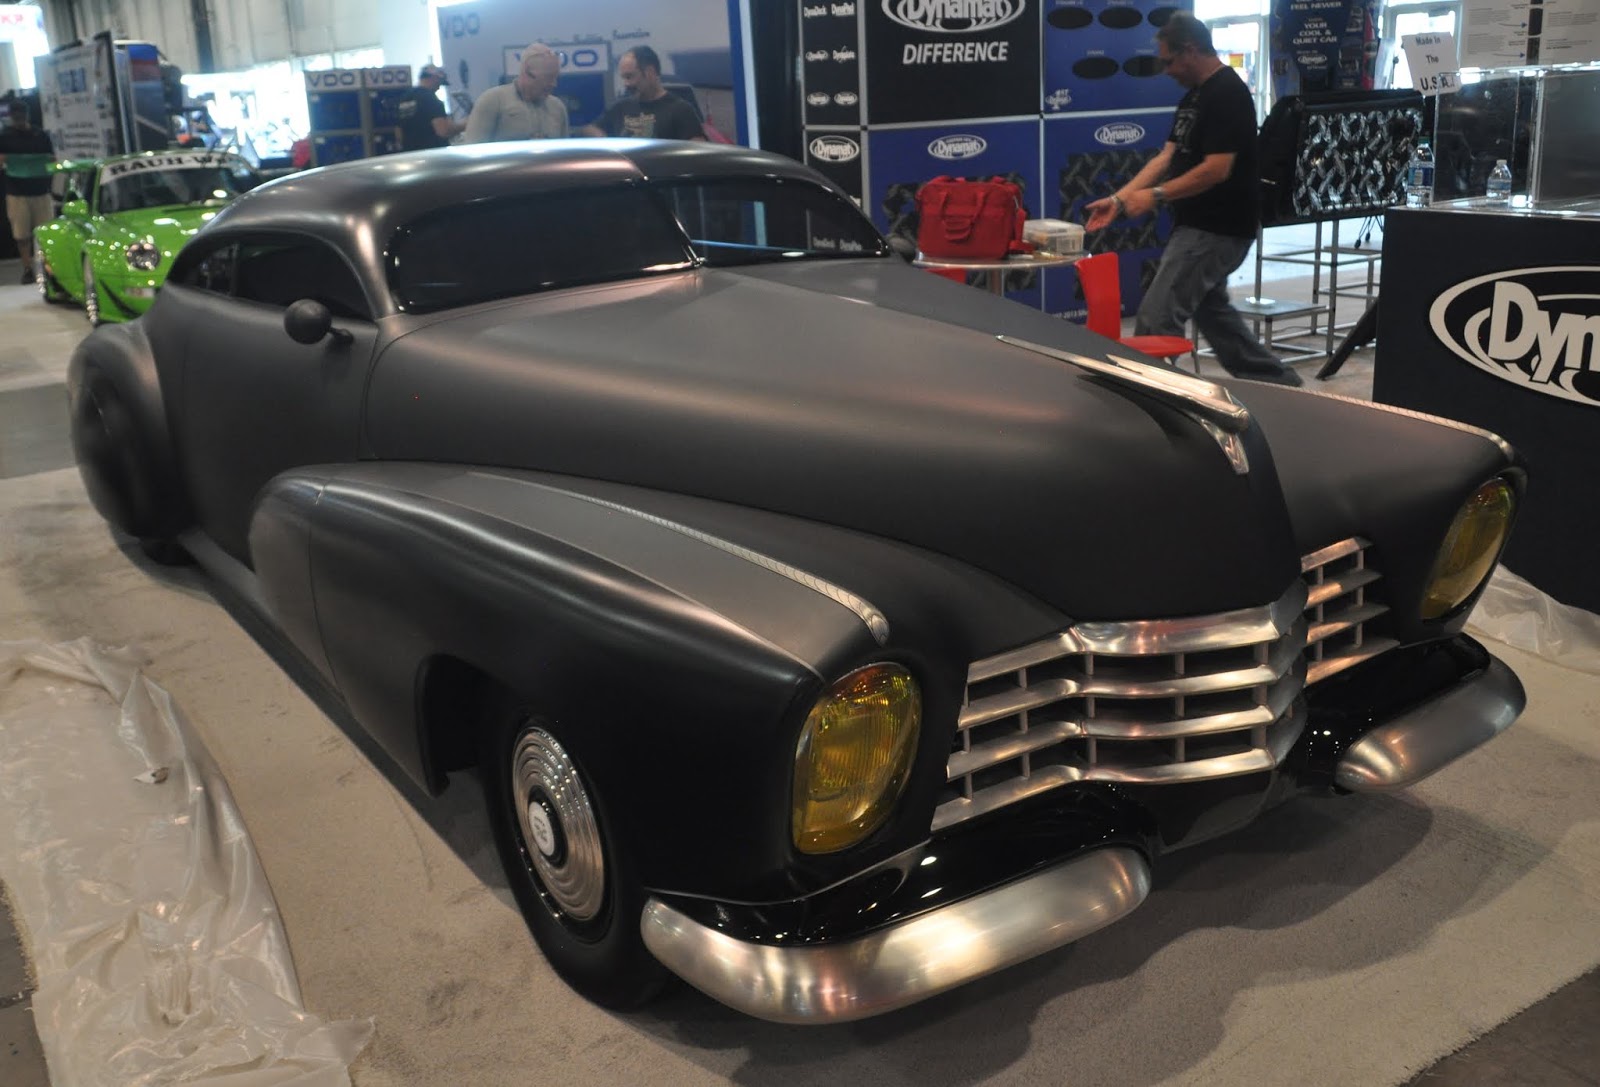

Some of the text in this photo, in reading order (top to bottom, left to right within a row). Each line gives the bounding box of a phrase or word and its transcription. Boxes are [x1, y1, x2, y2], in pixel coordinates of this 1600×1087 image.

[1311, 1, 1342, 9] NEWER
[906, 0, 1004, 26] Dynamat
[1303, 22, 1328, 30] YOUR
[1415, 36, 1433, 46] Made
[902, 41, 1009, 65] DIFFERENCE
[1425, 54, 1440, 64] The
[308, 72, 355, 87] VDO
[369, 70, 408, 84] VDO
[816, 139, 853, 159] Dynamat
[937, 139, 978, 157] Dynamat
